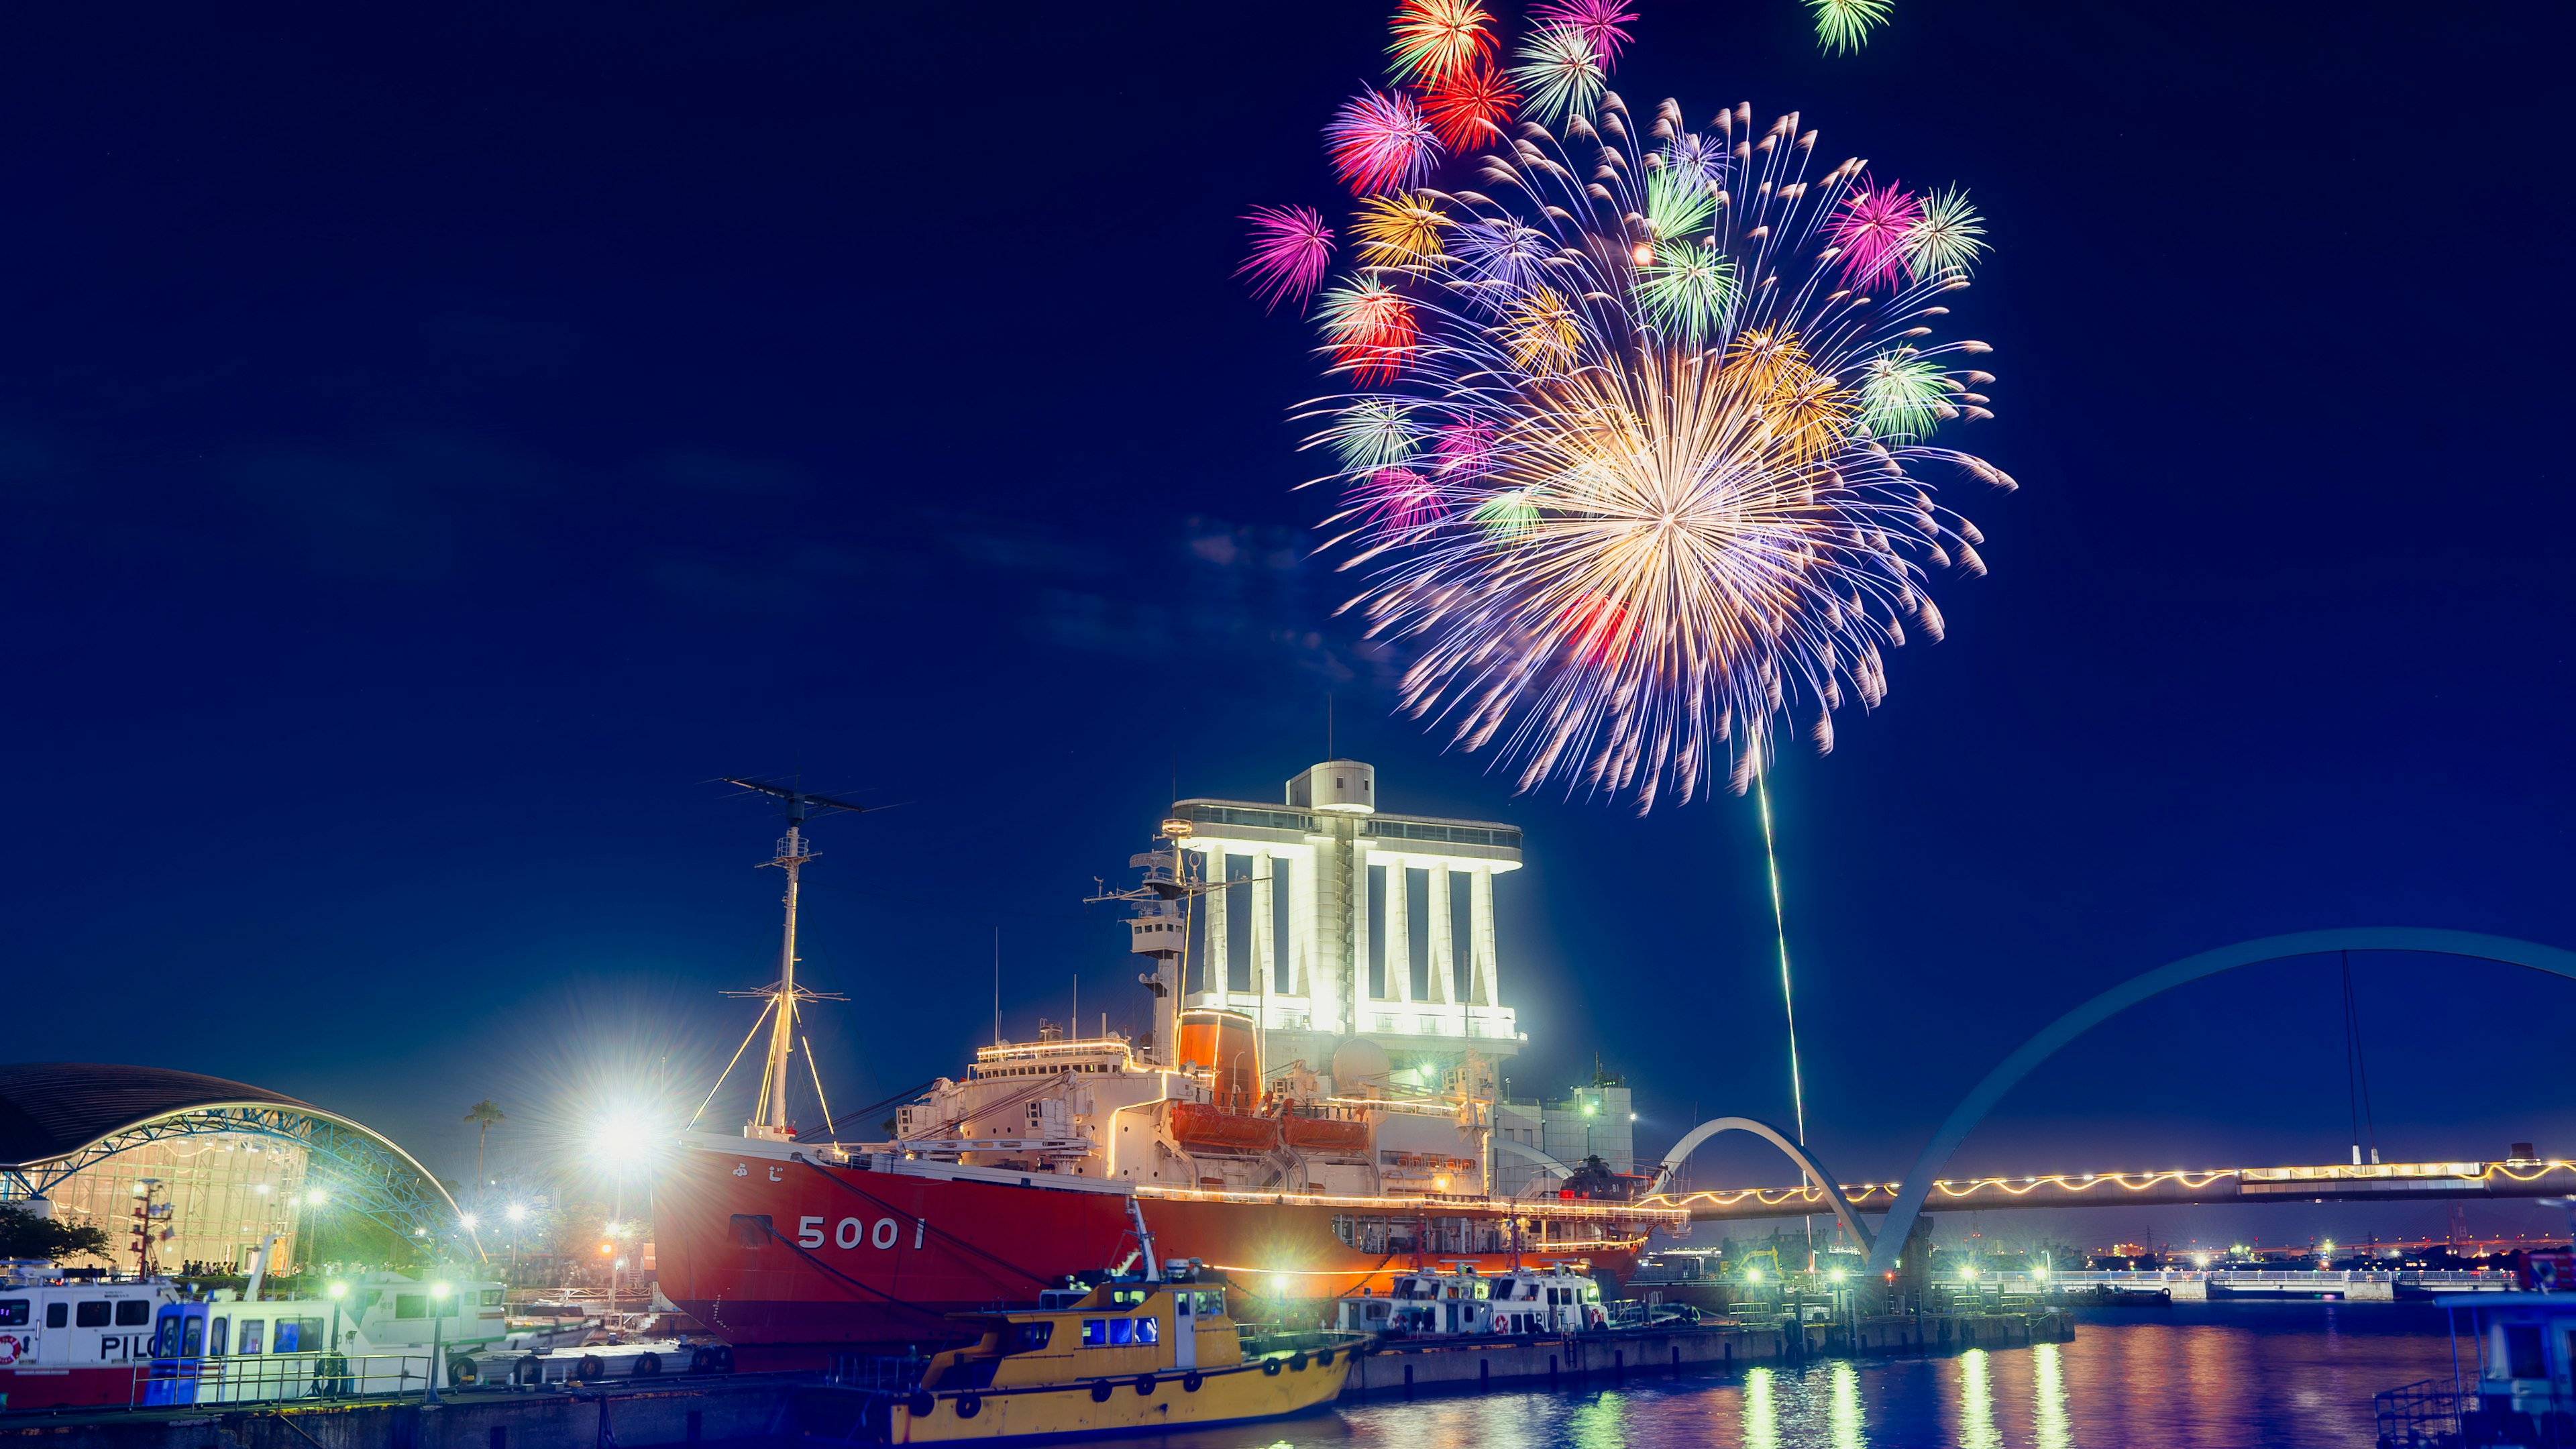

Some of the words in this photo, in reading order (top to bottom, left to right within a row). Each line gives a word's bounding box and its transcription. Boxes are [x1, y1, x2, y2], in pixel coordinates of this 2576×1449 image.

[733, 1163, 783, 1182] ふじ
[1612, 1183, 1619, 1193] 81
[798, 1216, 925, 1250] 5001
